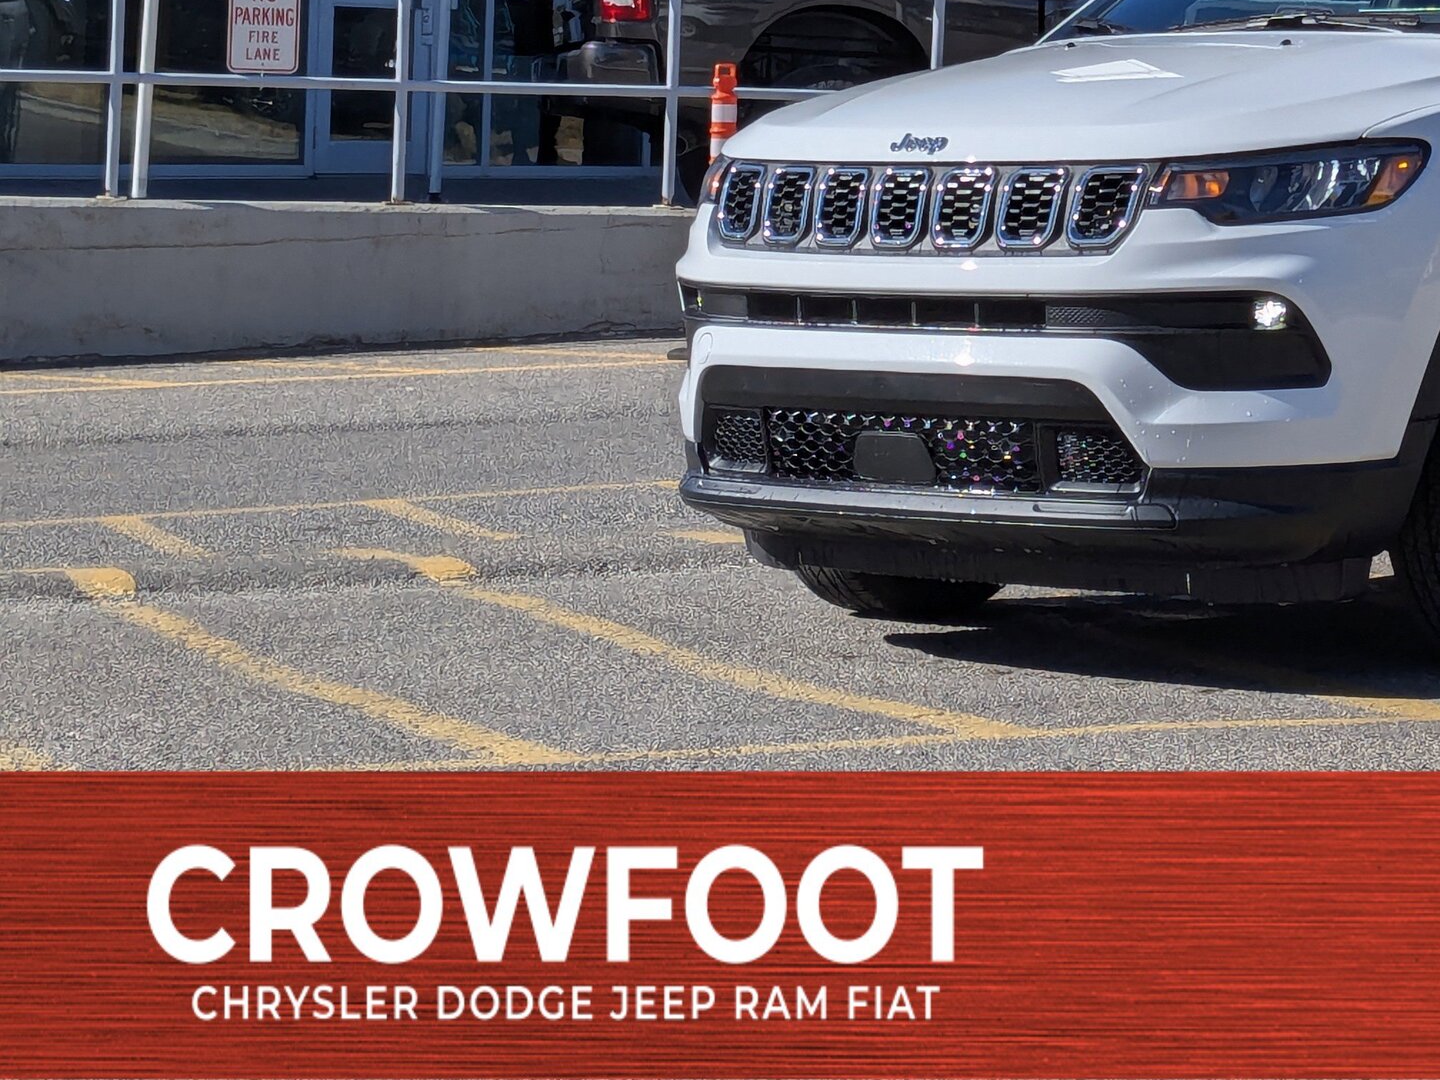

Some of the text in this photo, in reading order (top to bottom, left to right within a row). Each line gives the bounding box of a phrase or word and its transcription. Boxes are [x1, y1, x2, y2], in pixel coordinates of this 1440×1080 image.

[234, 7, 295, 27] PARKING
[248, 30, 279, 44] FIRE
[245, 47, 281, 61] LANE
[890, 132, 949, 155] Jeep
